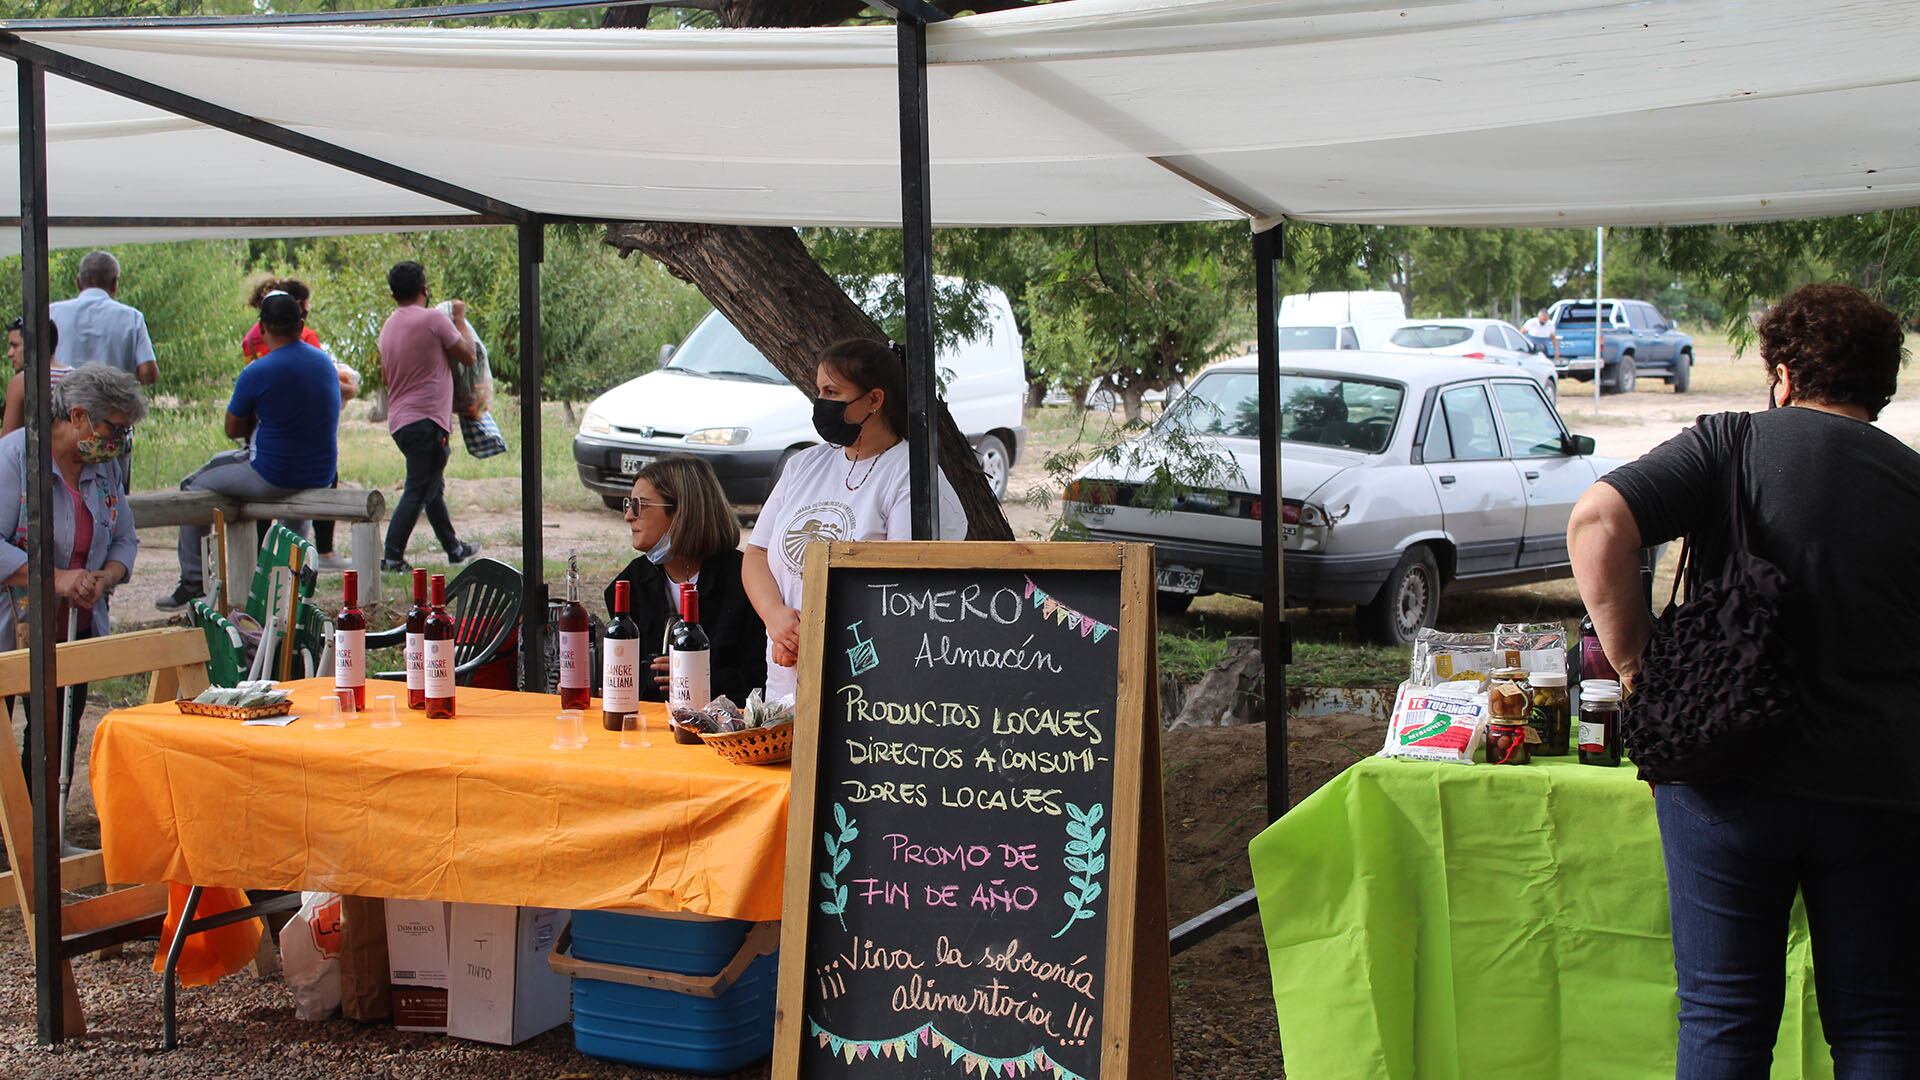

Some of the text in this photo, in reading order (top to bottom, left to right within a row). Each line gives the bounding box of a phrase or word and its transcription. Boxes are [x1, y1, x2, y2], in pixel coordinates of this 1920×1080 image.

[1177, 573, 1200, 589] 325
[867, 583, 1024, 625] TOMERO
[914, 632, 1063, 674] Almacén
[837, 684, 1103, 745] PRODUCTOS LOCALES
[1410, 700, 1424, 709] TE
[1408, 719, 1447, 740] MISIONES
[975, 747, 996, 773] A
[1001, 747, 1110, 774] CONSUMI-
[841, 780, 1062, 816] DORES LOCALES
[883, 833, 1040, 872] PROMO DE
[852, 877, 1038, 913] FIN DE AÑO
[473, 939, 488, 952] T
[466, 963, 493, 980] TINTO
[935, 935, 972, 971] la
[977, 938, 1096, 1000] soberanía
